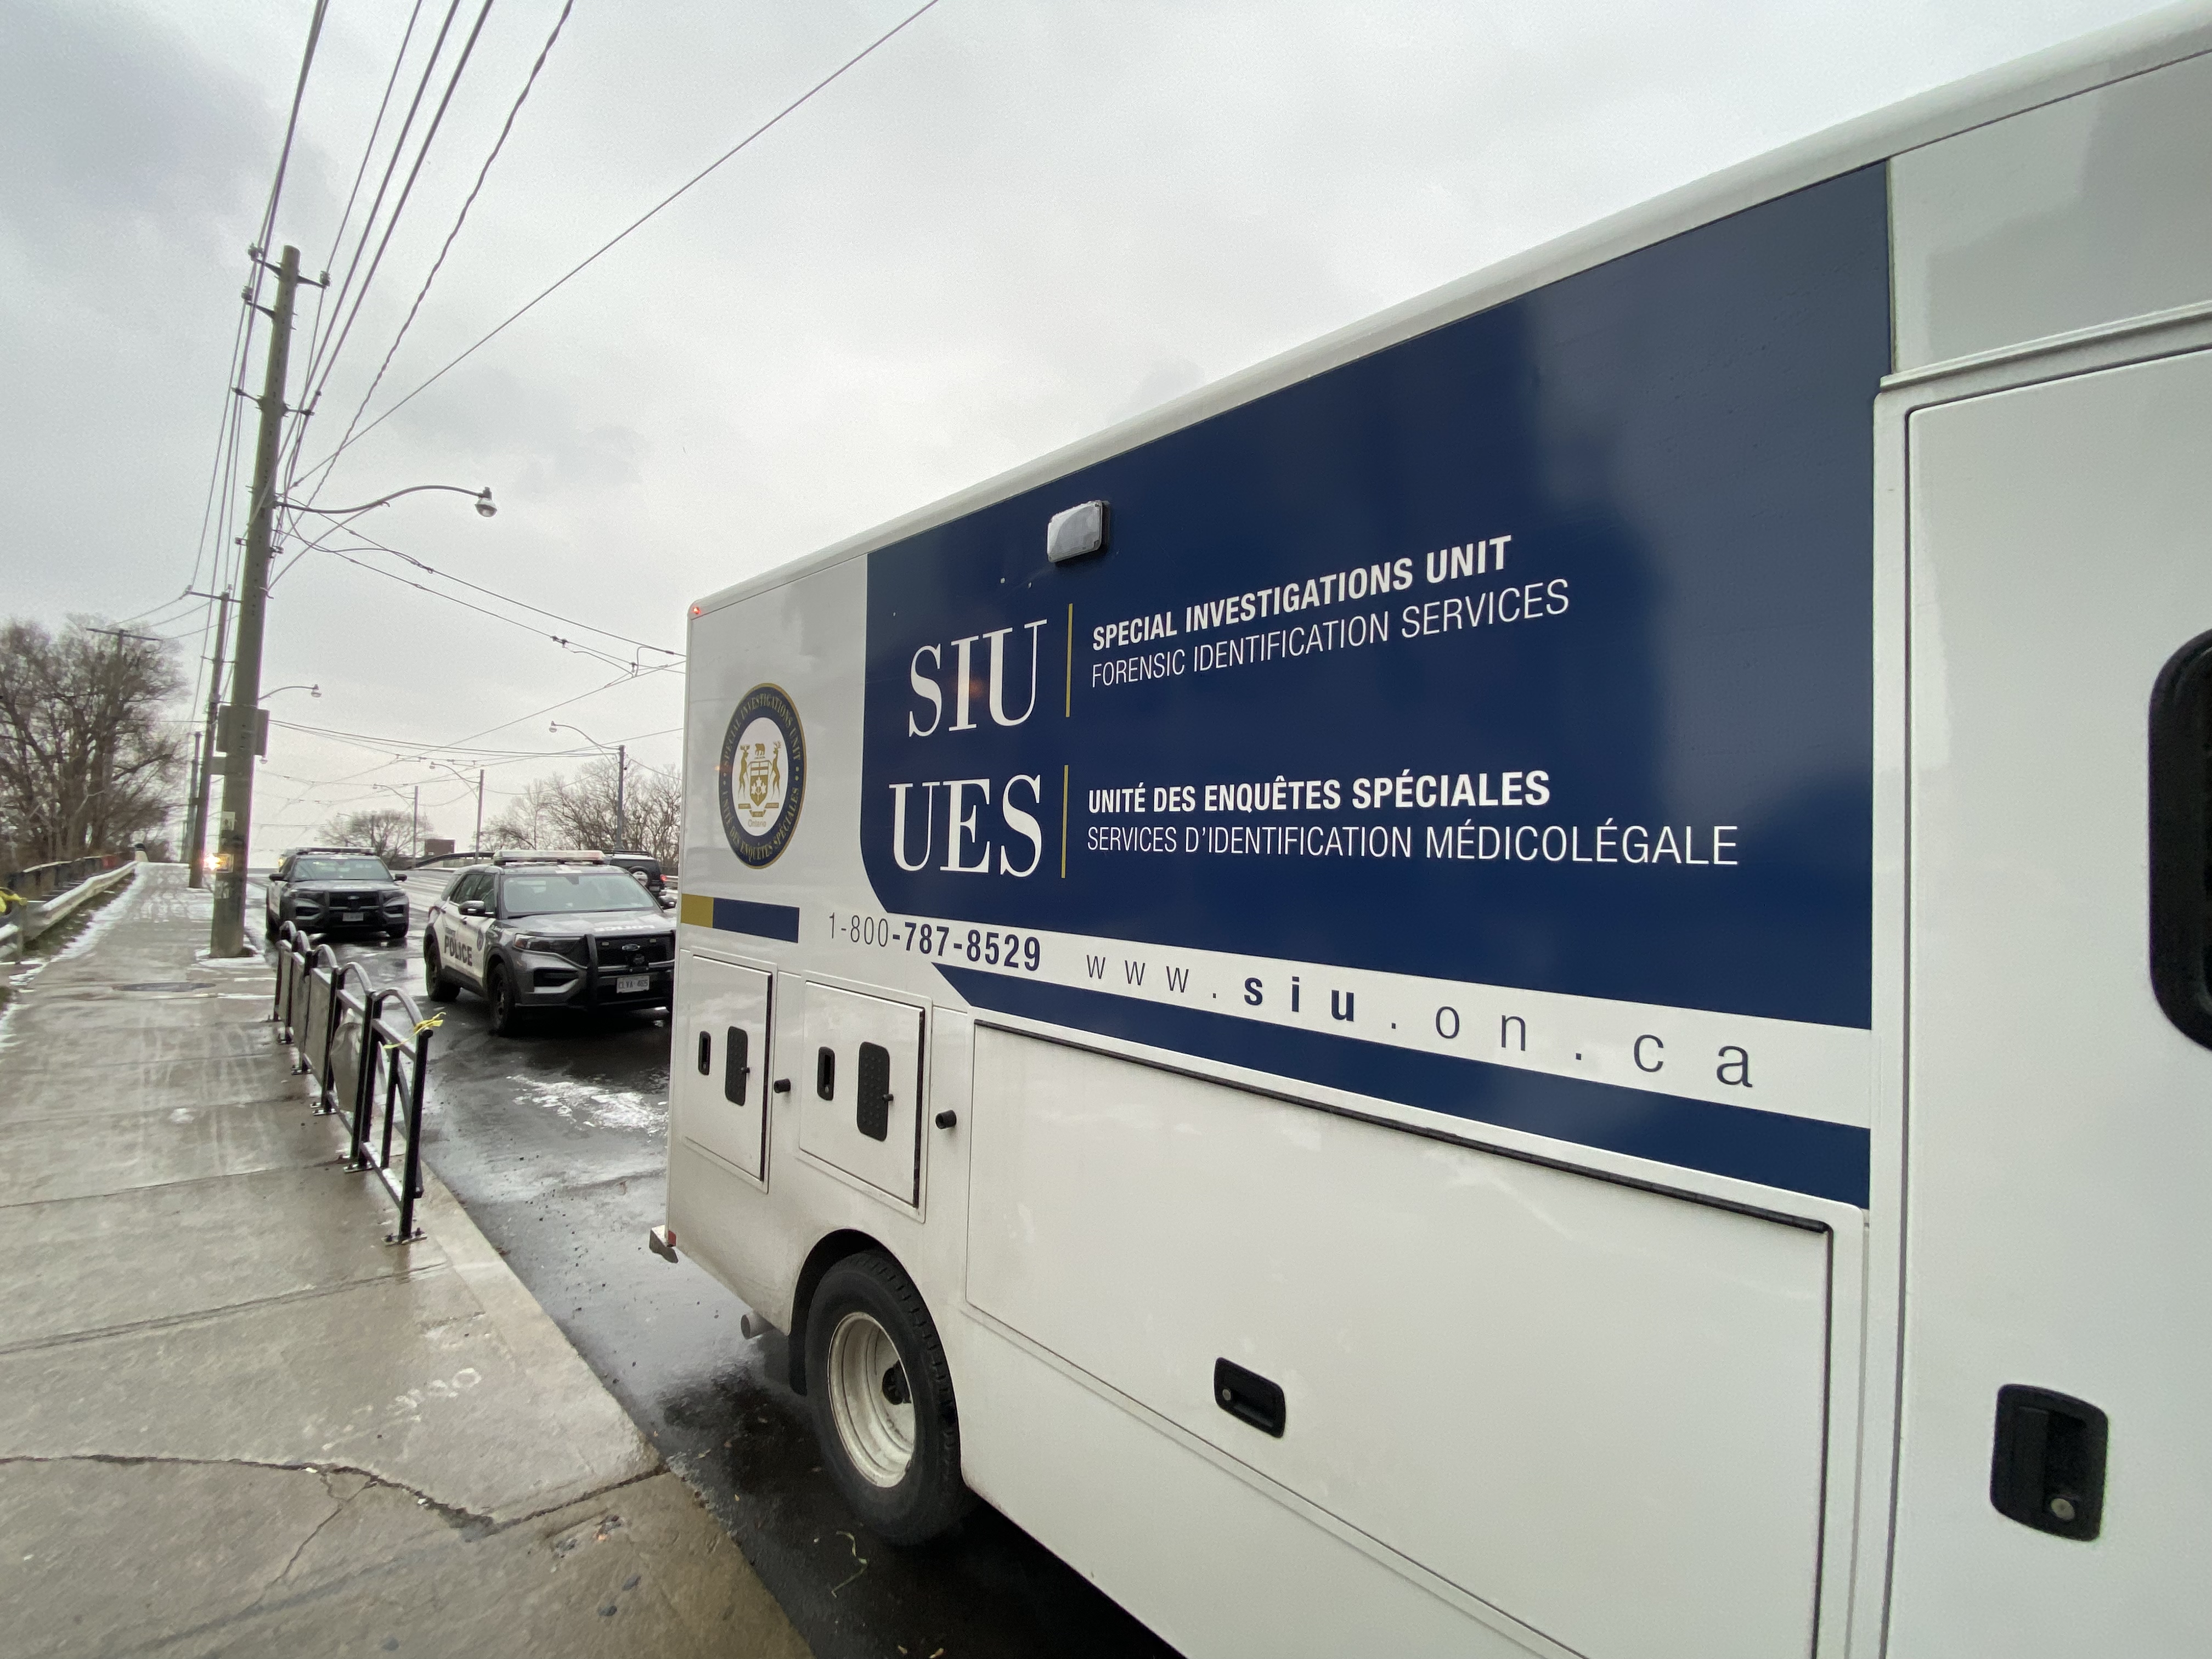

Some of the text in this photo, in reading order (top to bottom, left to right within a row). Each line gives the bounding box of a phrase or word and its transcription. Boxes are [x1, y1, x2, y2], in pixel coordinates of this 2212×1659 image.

[1093, 534, 1512, 651] SPECIAL INVESTIGATIONS UNIT
[1092, 578, 1569, 688] FORENSIC IDENTIFICATION SERVICES
[909, 619, 1047, 737] SIU
[741, 693, 793, 728] INVESTIGATIONS
[789, 727, 801, 760] UNIT
[748, 819, 767, 827] Ontario
[1089, 769, 1550, 814] UNITÉ DES ENQUÊTES SPÉCIALES
[889, 774, 1042, 878] UES
[1087, 817, 1738, 865] SERVICES D'IDENTIFICATION MÉDICOLÉGALE
[444, 934, 472, 967] POLICE
[829, 912, 1041, 972] 1-800-787-8529
